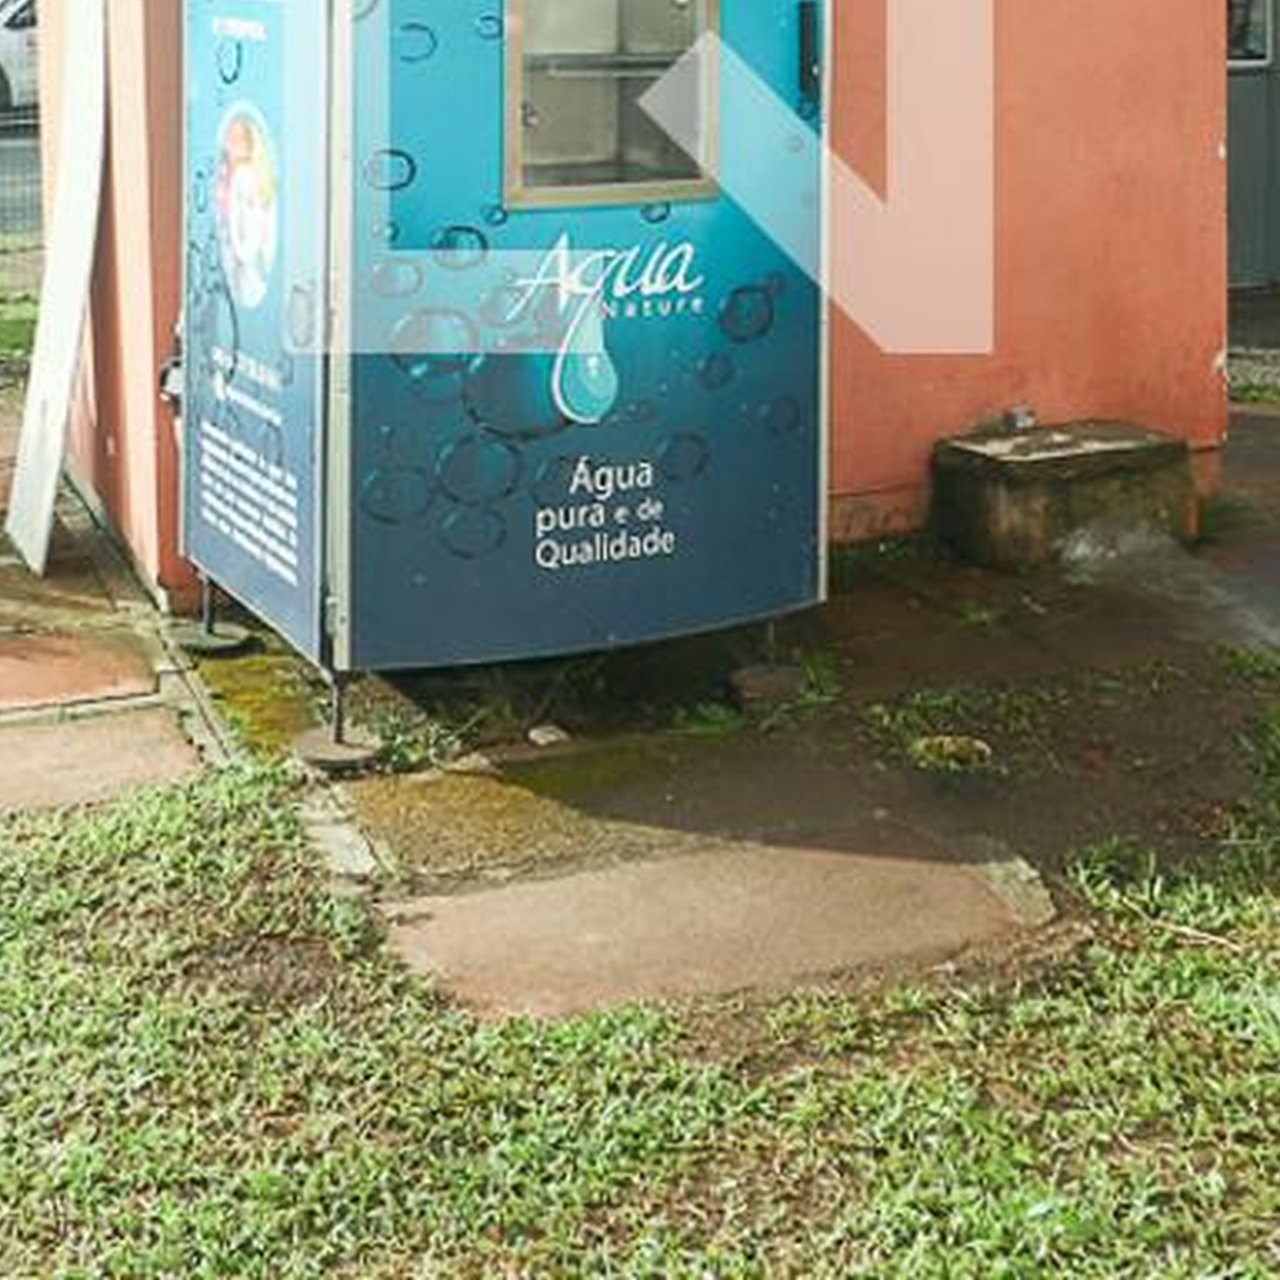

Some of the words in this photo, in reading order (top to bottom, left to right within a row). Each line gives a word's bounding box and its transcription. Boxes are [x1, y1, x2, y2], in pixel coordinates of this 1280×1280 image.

[505, 231, 705, 325] Aqua
[601, 296, 705, 319] Nature
[568, 454, 654, 501] Água
[535, 502, 606, 539] pura
[613, 505, 631, 524] e
[636, 496, 664, 521] de
[535, 525, 675, 568] Qualidade
